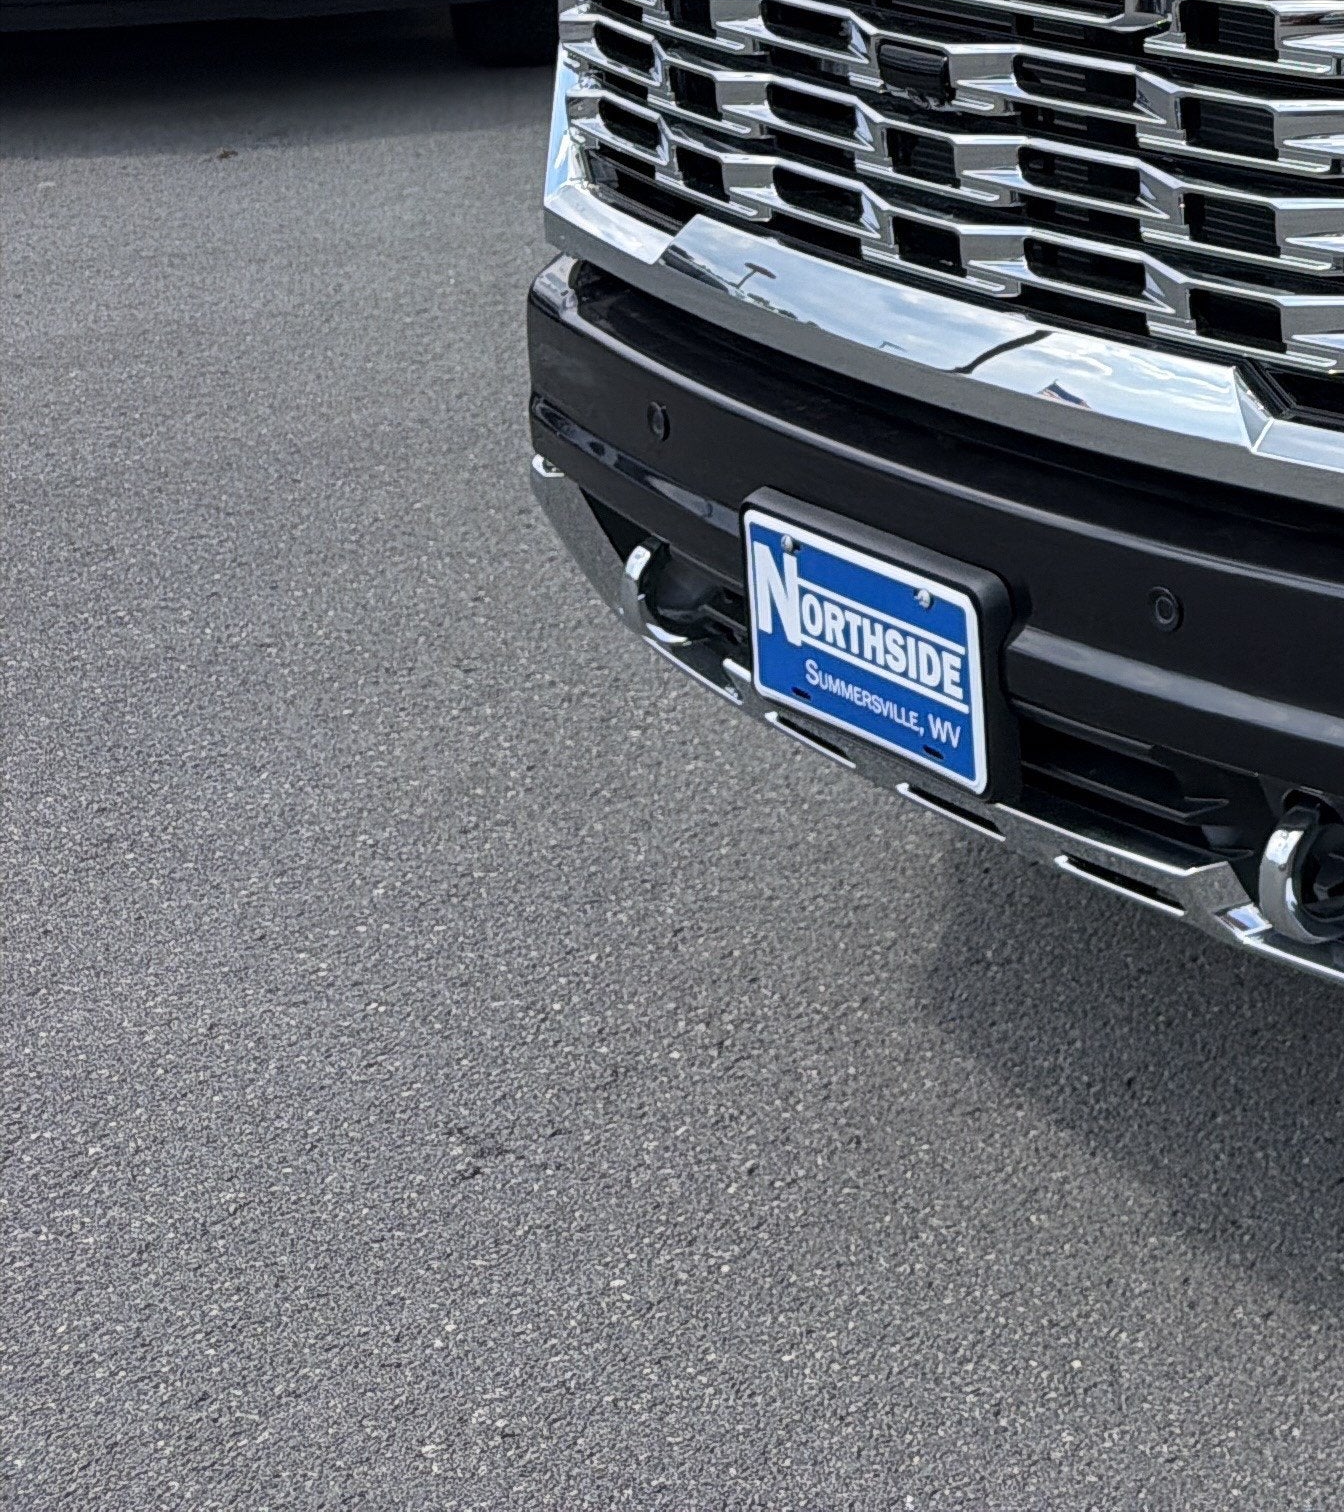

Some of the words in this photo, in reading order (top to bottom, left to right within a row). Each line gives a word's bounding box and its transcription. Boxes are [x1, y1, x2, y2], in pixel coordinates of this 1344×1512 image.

[752, 540, 965, 701] NORTHSIDE
[804, 658, 926, 737] SUMMERSVILLE,
[927, 712, 962, 749] WV
